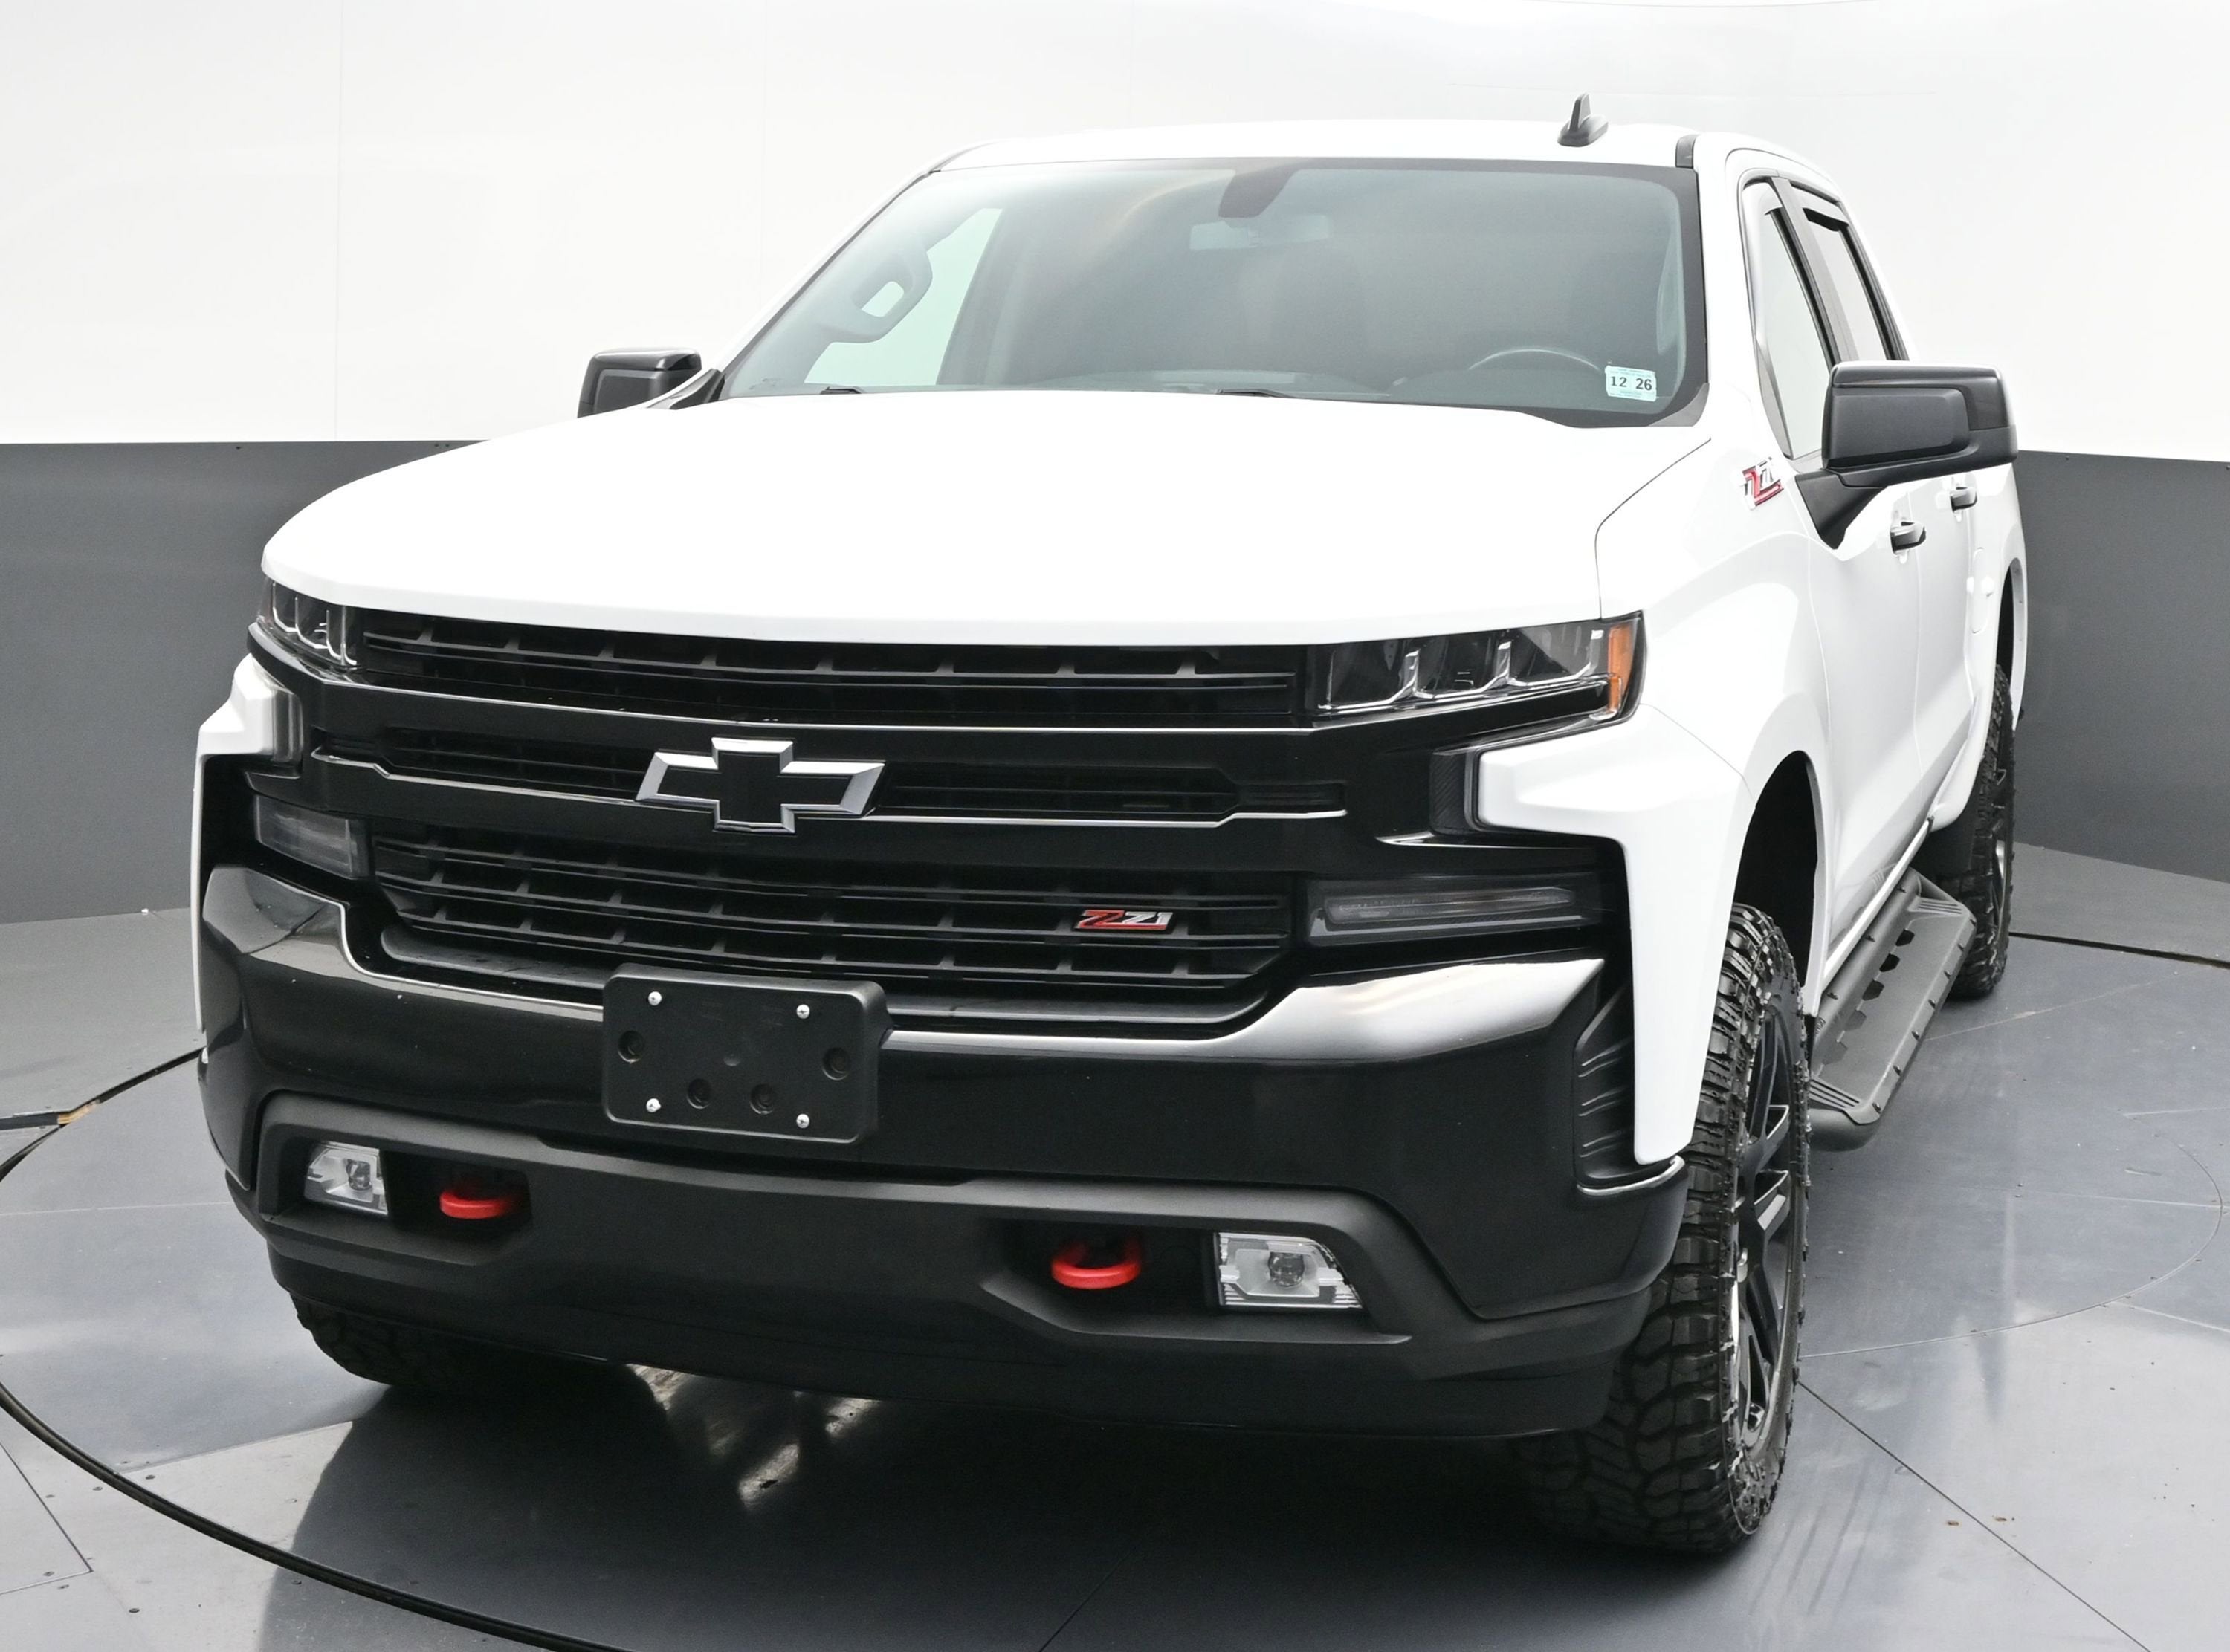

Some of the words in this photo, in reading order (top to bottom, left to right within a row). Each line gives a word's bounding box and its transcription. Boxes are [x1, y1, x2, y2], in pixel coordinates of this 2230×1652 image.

[1611, 376, 1627, 387] 12
[1635, 378, 1652, 391] 26
[1075, 909, 1173, 930] Z71
